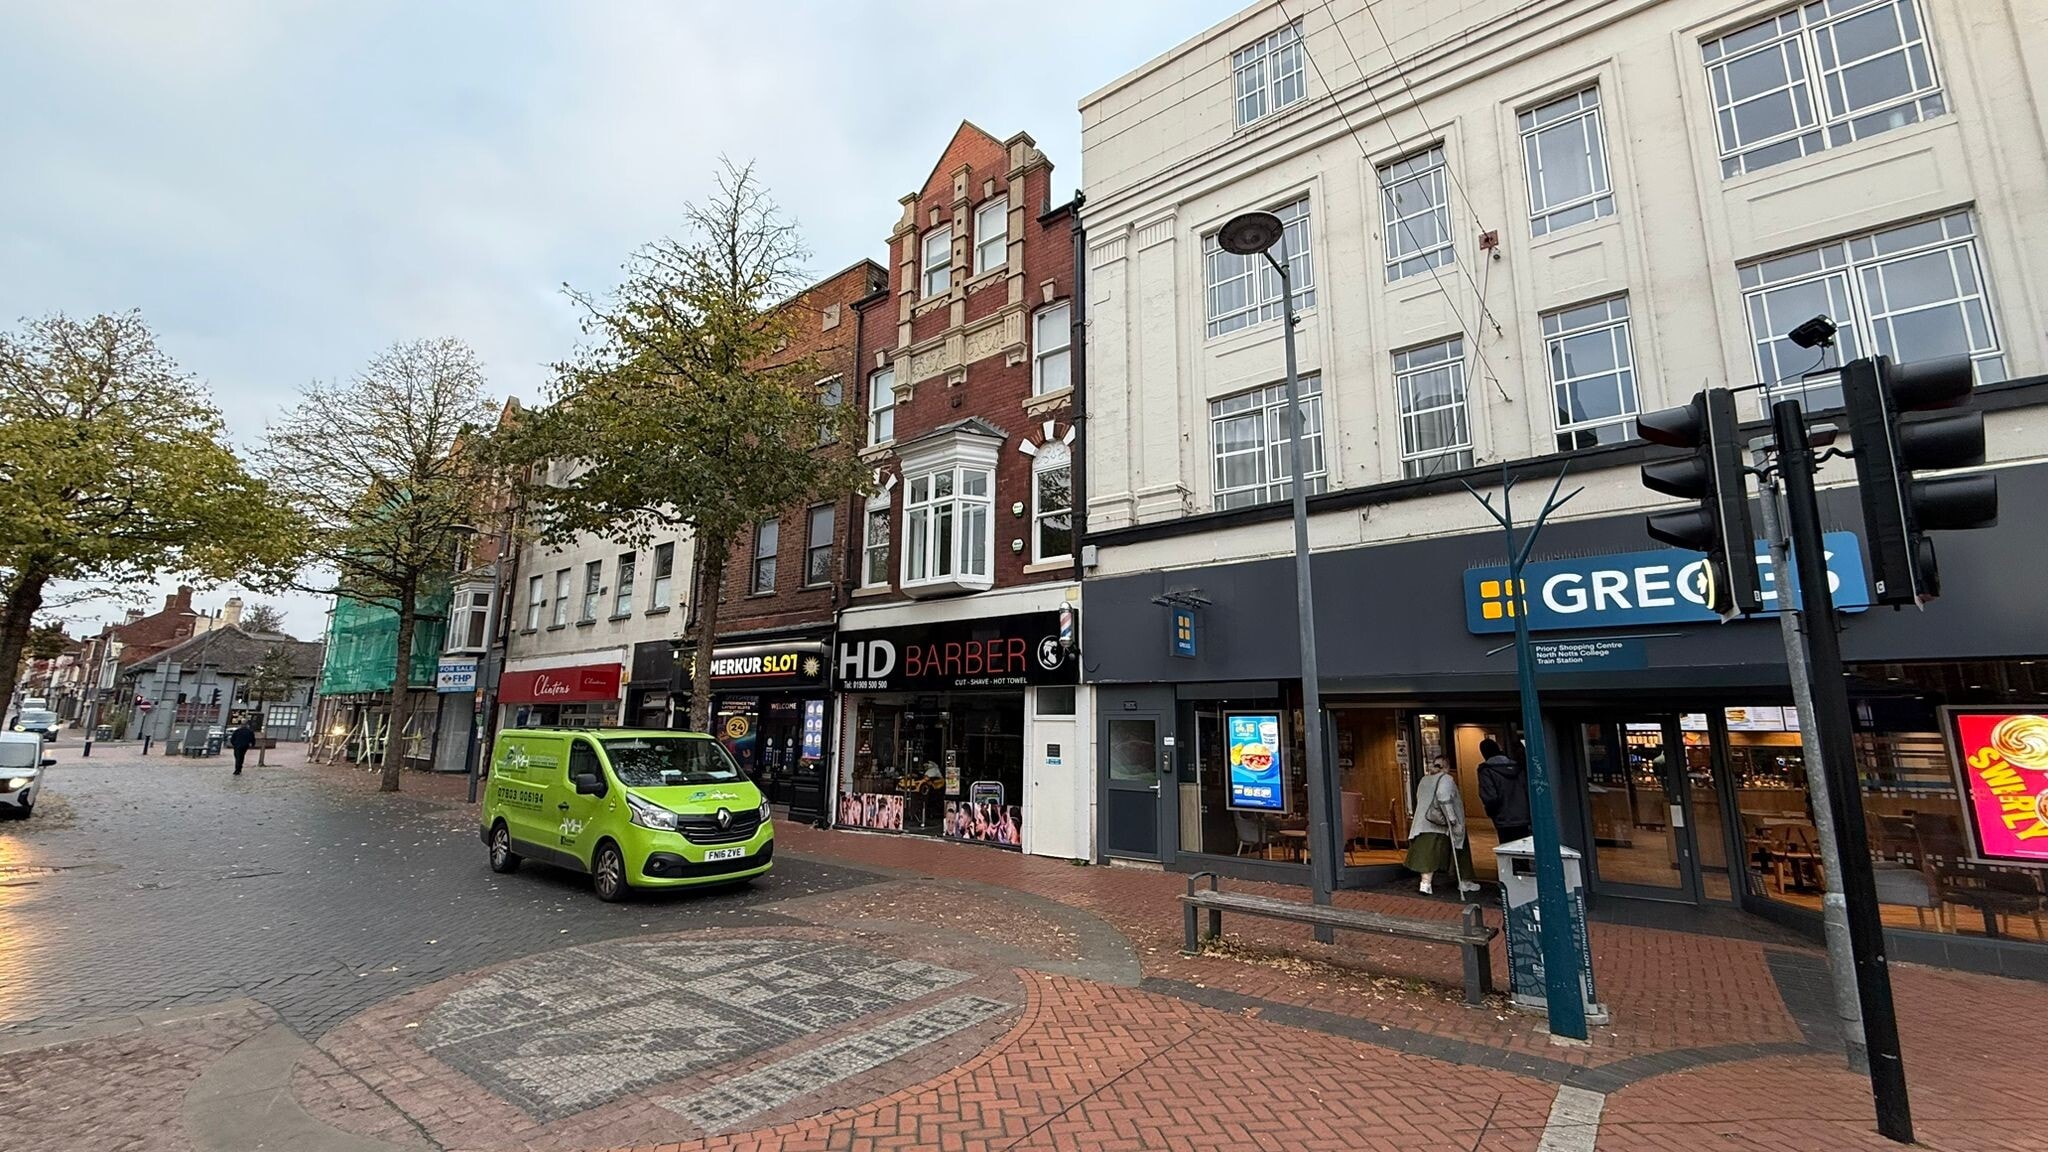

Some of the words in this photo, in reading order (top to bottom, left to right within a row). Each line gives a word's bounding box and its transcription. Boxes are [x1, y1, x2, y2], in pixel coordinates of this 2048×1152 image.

[1558, 643, 1595, 651] Shopping
[1580, 649, 1610, 657] College
[839, 639, 896, 679] HD
[905, 638, 1027, 677] BARBER
[710, 657, 762, 675] MERKUR
[452, 674, 472, 682] FHP
[1007, 677, 1028, 685] TOWEL
[534, 674, 571, 697] Clintons
[868, 681, 878, 689] 500
[878, 680, 888, 689] 500
[771, 702, 797, 710] WELCOME
[731, 723, 744, 732] 24
[708, 850, 727, 860] FN16
[727, 848, 742, 858] ZVE
[1576, 895, 1590, 967] NOTTINGHAMSHIRE
[1585, 968, 1594, 995] NORTH
